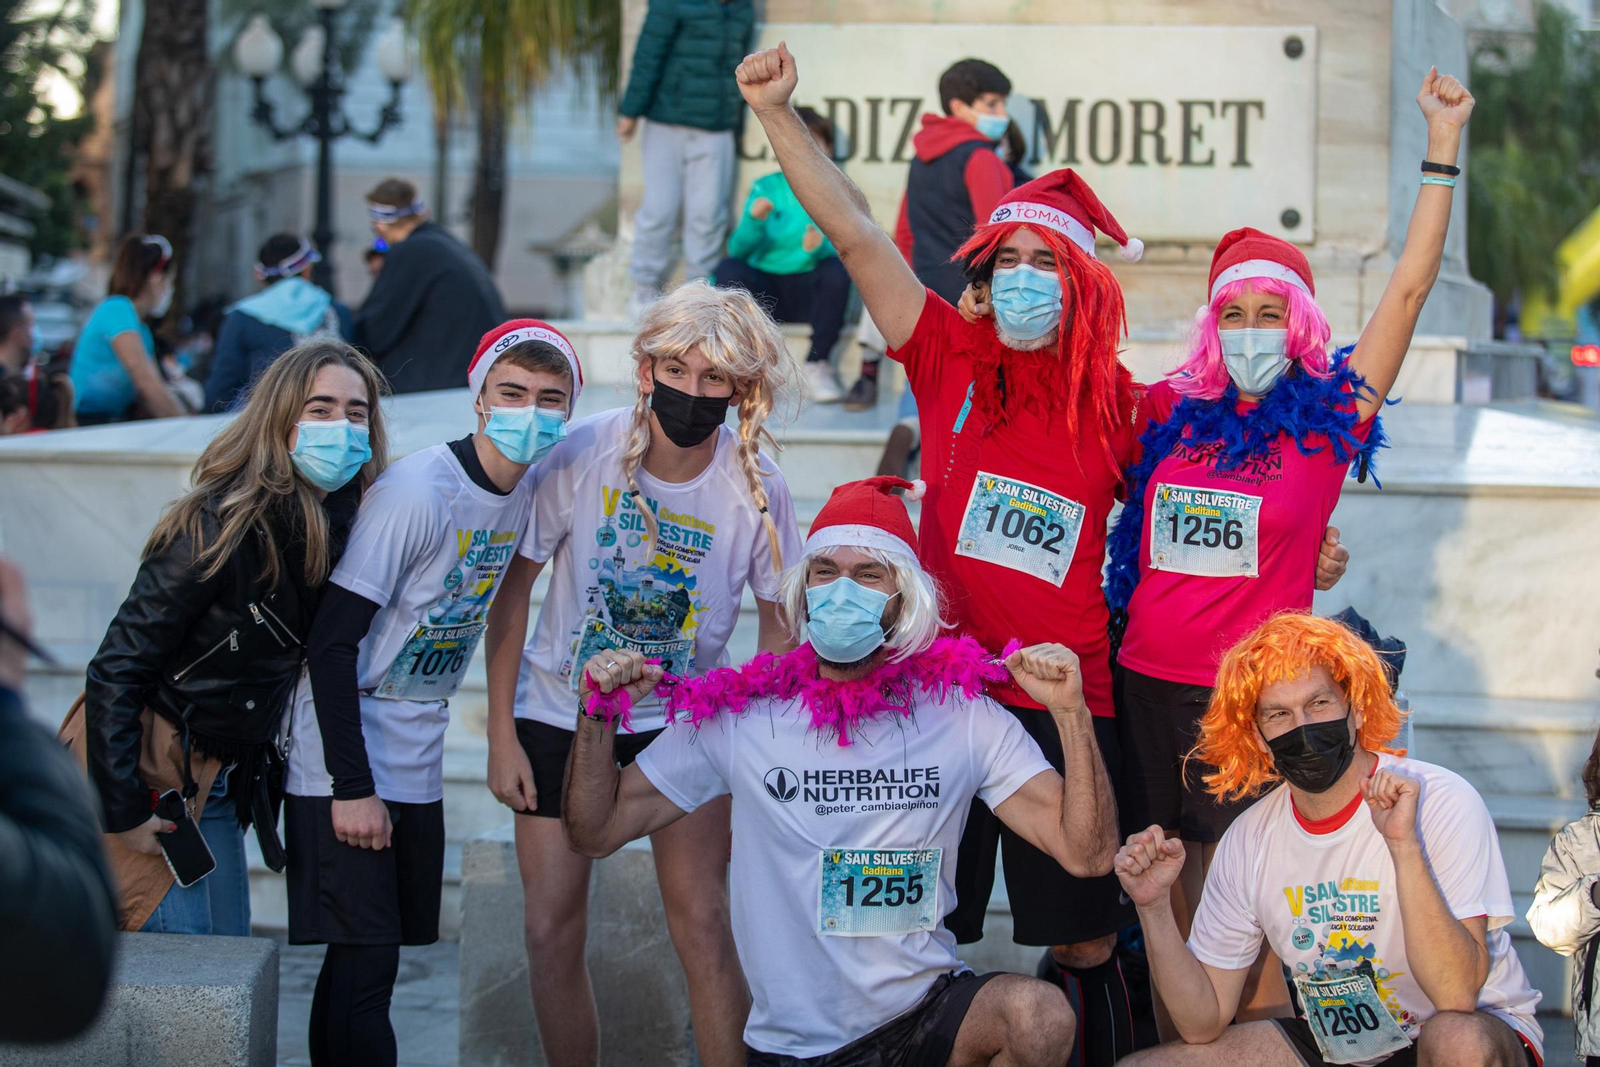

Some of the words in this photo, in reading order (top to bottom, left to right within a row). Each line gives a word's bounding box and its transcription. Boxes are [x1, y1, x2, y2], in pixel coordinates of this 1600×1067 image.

[1028, 97, 1266, 168] MORET
[1016, 208, 1070, 230] TOMAX
[602, 485, 622, 517] V
[621, 491, 658, 515] SN
[986, 479, 995, 491] V
[996, 482, 1020, 498] SAN
[1021, 488, 1080, 520] SILVESTRE
[1009, 498, 1047, 517] Gaditana
[1162, 489, 1170, 501] V
[1171, 490, 1192, 504] SAN
[1194, 493, 1252, 510] SILVESTRE
[1184, 505, 1221, 517] Gaditana
[618, 512, 714, 552] SILESTRE
[986, 503, 1066, 556] 1062
[1168, 513, 1244, 551] 1256
[456, 529, 473, 558] V
[1006, 543, 1026, 553] JORGE
[425, 630, 446, 640] SAN
[595, 621, 604, 632] V
[604, 628, 624, 647] SAN
[625, 641, 685, 655] SILVESTRE
[409, 646, 468, 676] 1076
[803, 766, 940, 785] HERBALIFE
[803, 782, 940, 803] NUTRITION
[814, 800, 939, 816] @peter_cambiaelpiñon
[831, 852, 840, 864] V
[844, 853, 870, 865] SAN
[873, 851, 933, 866] SILVESTRE
[862, 866, 903, 876] Gaditana
[840, 874, 924, 907] 1255
[1340, 877, 1380, 891] ditana
[1283, 885, 1303, 917] V
[1308, 893, 1381, 924] SILSTRE
[1306, 986, 1320, 998] SAN
[1320, 980, 1368, 996] SILVESTRE
[1313, 1002, 1380, 1037] 1260
